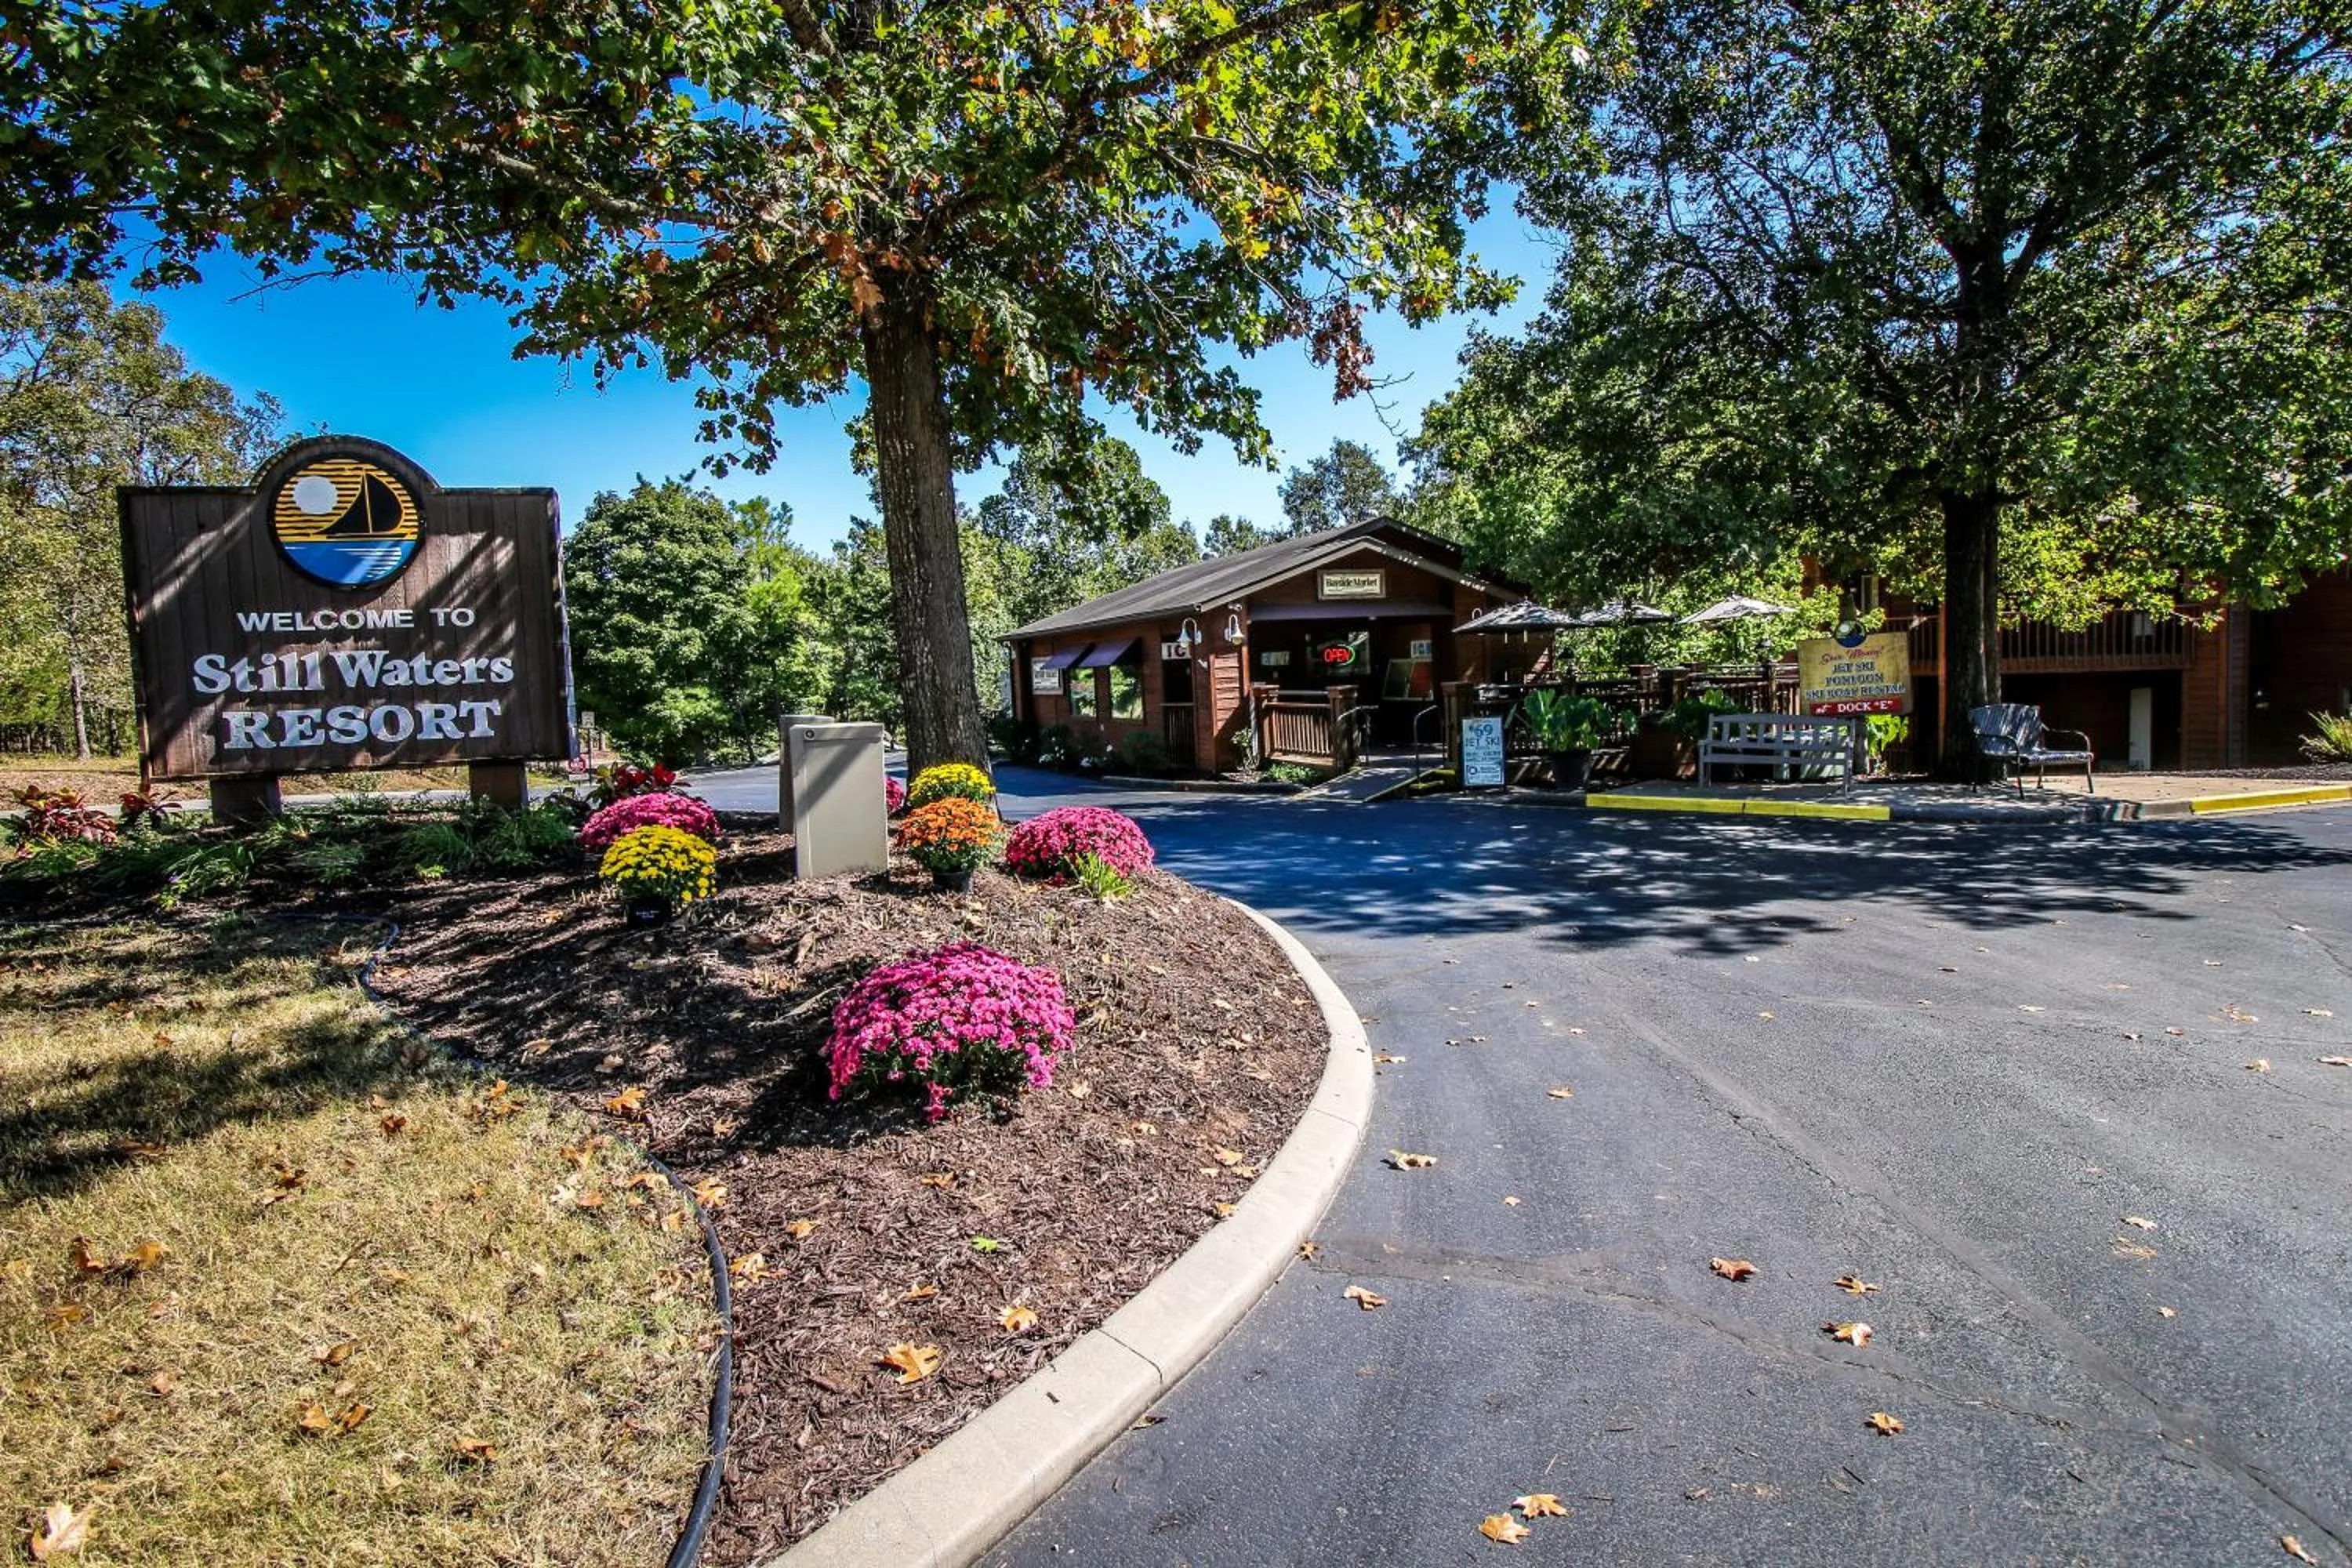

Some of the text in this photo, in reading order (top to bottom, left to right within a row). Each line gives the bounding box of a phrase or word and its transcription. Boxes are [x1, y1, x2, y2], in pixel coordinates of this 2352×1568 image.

[237, 607, 476, 632] WELCOME TO
[1324, 648, 1350, 662] OPEN
[192, 649, 514, 694] Still Waters
[1833, 659, 1875, 673] JET SKI
[1837, 702, 1871, 713] DOCK
[221, 699, 502, 750] RESORT
